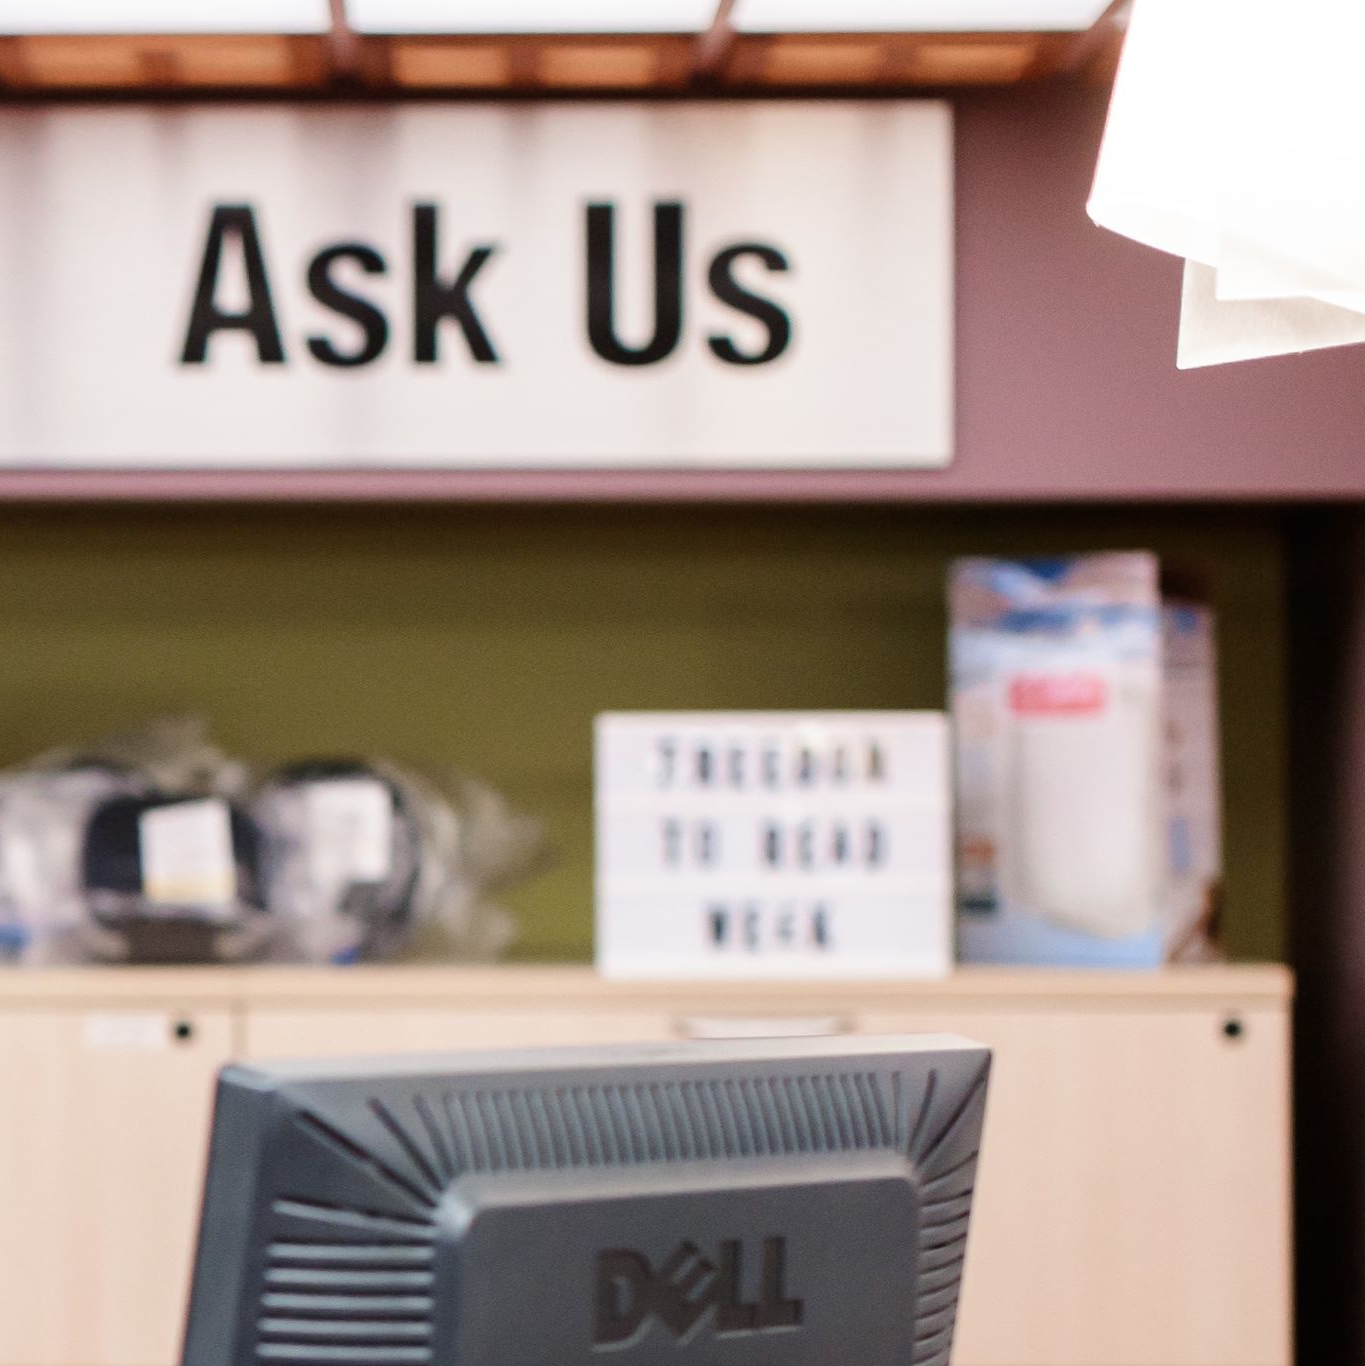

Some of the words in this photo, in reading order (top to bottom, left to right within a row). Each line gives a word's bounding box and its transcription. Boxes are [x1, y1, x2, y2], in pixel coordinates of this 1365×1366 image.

[177, 201, 501, 370] Ask
[583, 199, 794, 368] Us
[662, 819, 716, 865] TO
[591, 1234, 804, 1352] DELL
